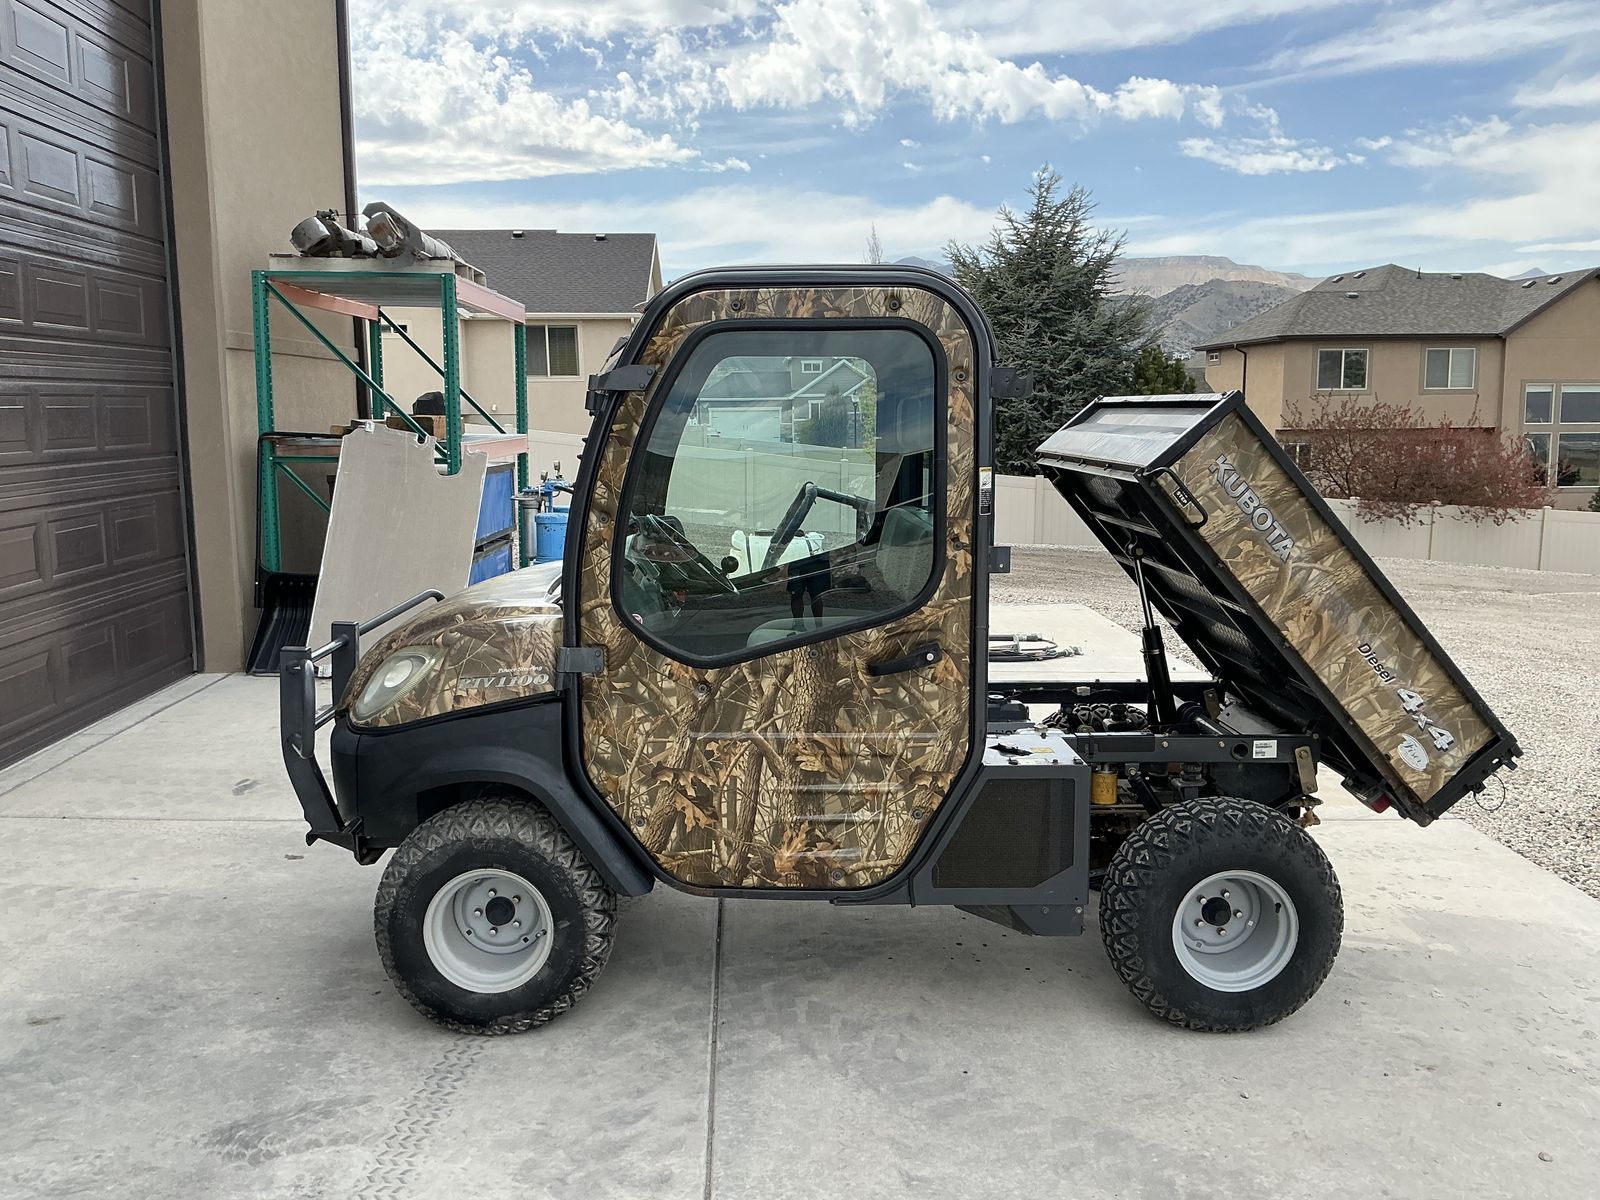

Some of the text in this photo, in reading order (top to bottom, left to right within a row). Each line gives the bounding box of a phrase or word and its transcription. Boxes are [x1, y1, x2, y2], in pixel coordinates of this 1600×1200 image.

[1176, 490, 1188, 504] STEP
[1208, 453, 1294, 563] KUBOTA
[1357, 643, 1396, 684] Diesel
[1397, 688, 1454, 752] 4x4
